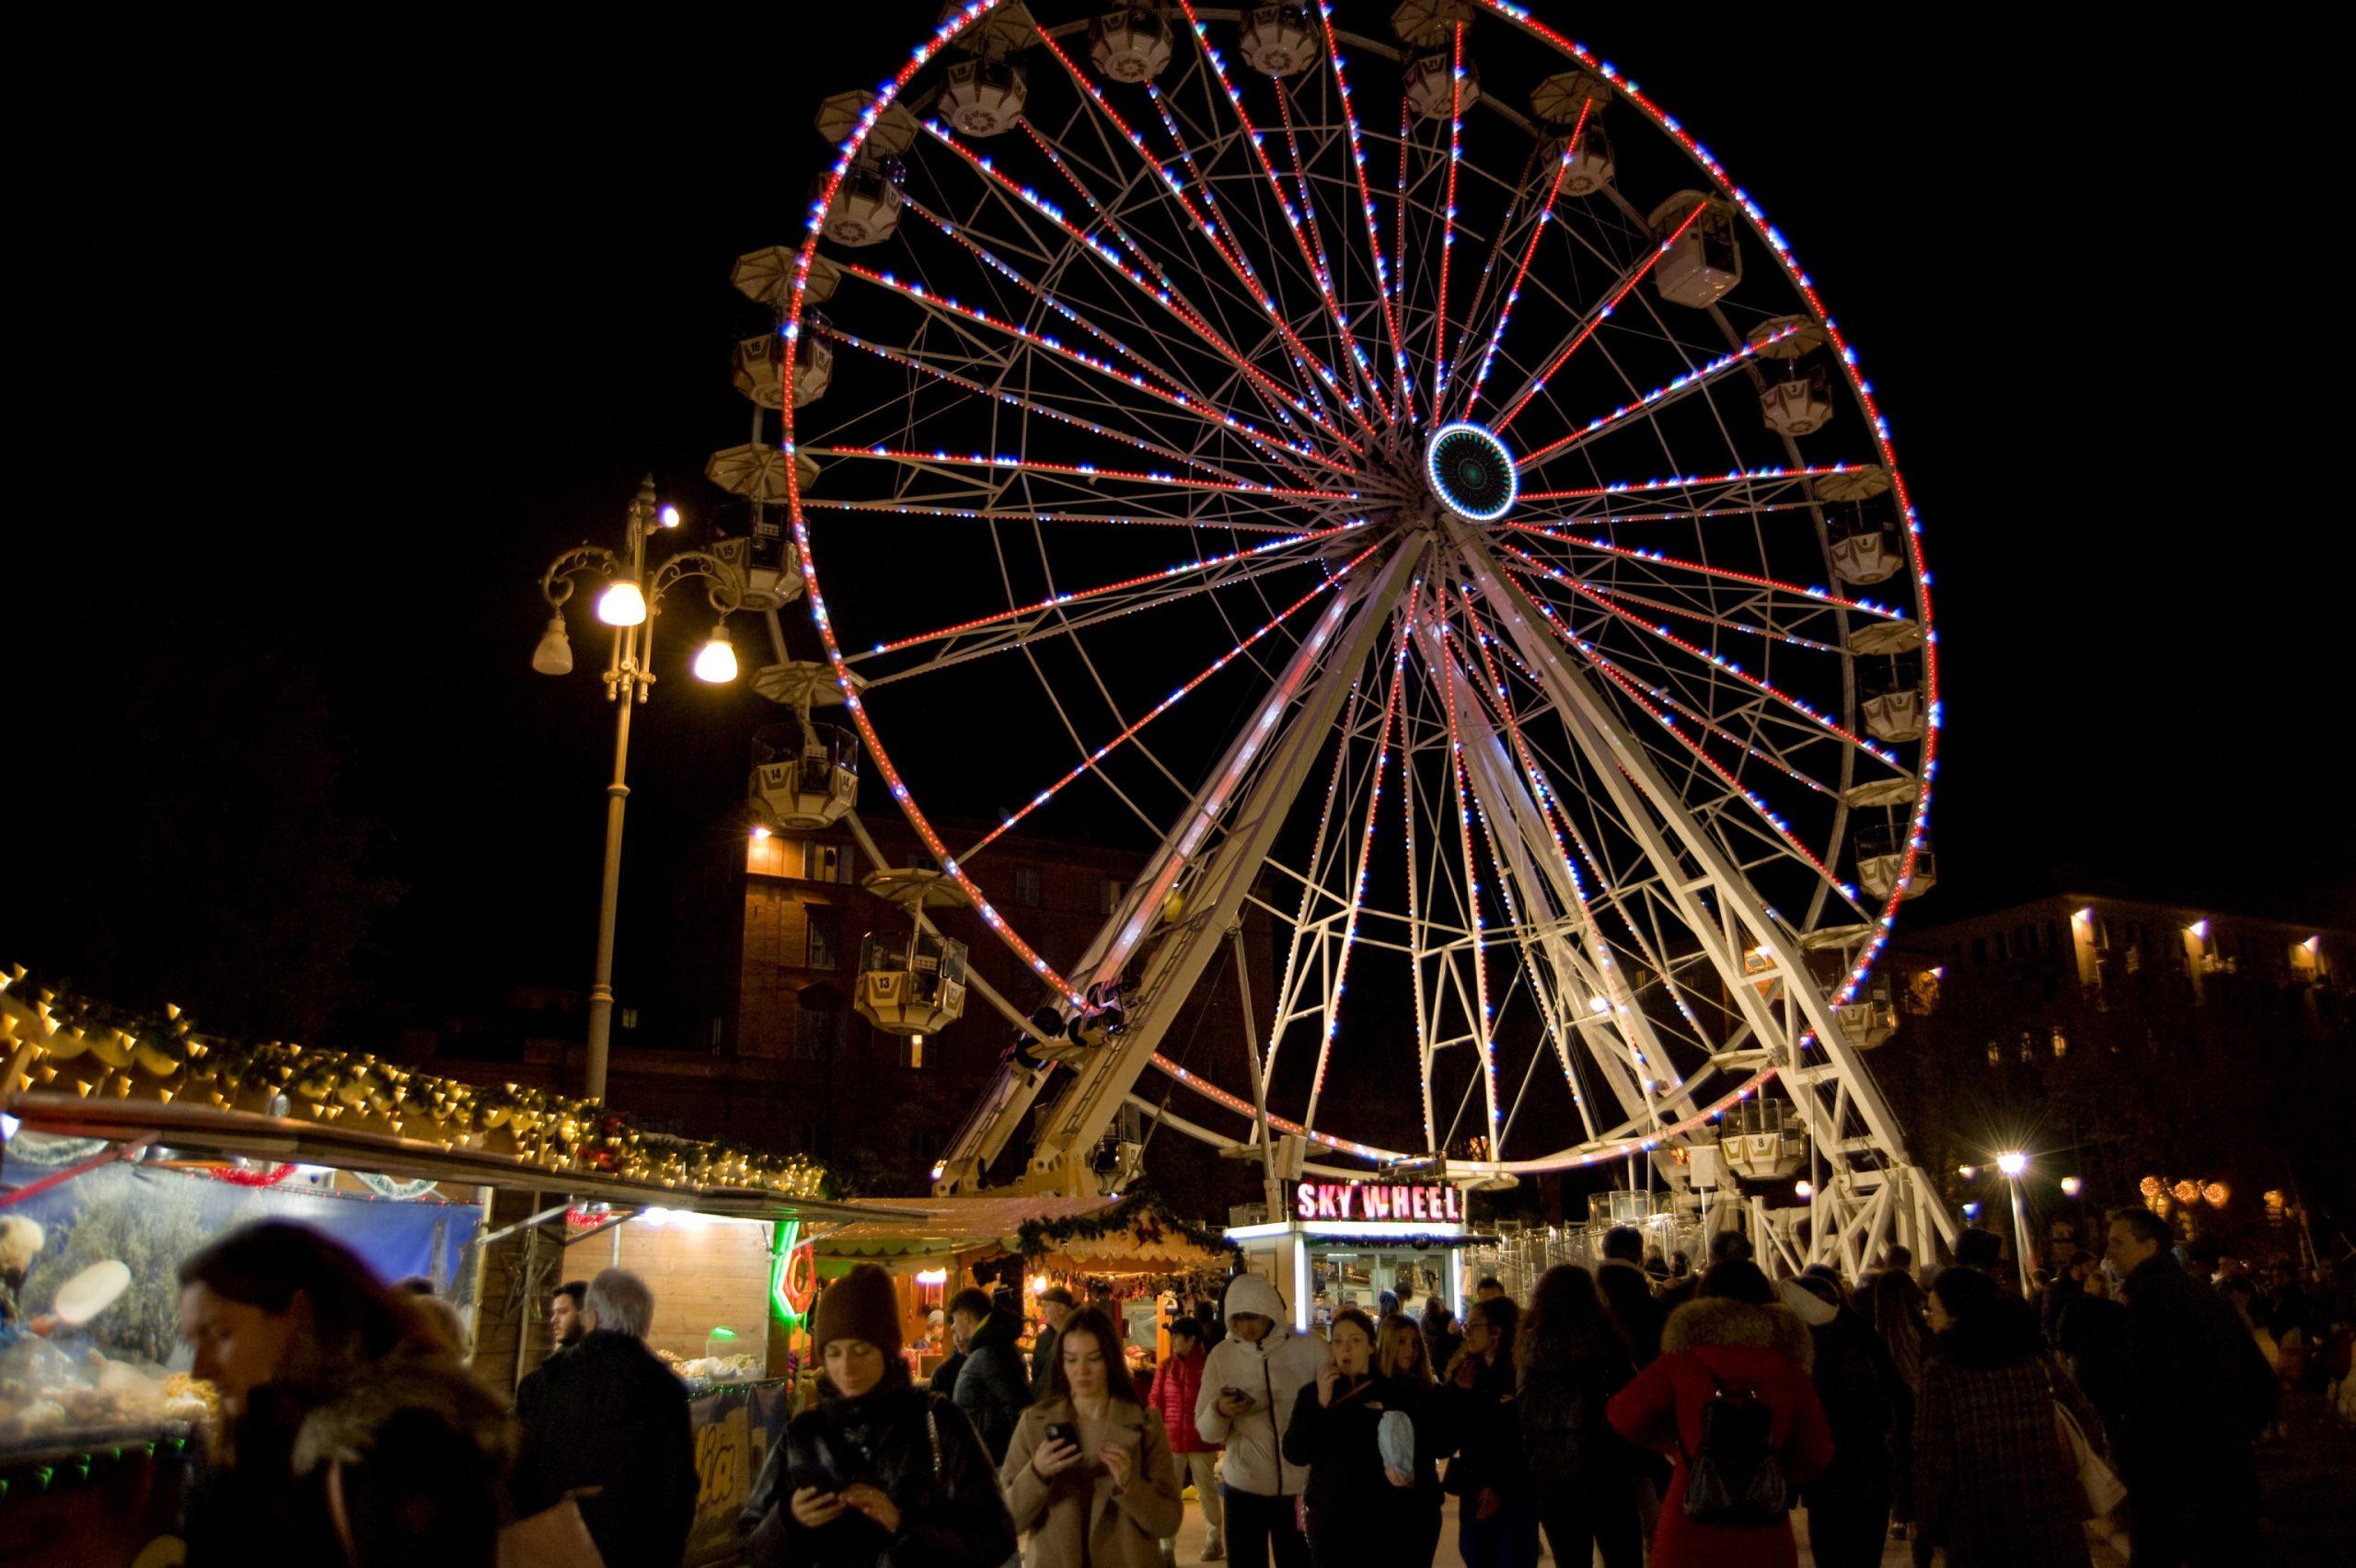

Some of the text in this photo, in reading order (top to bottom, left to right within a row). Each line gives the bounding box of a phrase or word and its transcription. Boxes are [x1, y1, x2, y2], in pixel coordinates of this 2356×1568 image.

[723, 545, 734, 557] 15
[771, 767, 781, 780] 14
[879, 976, 890, 989] 13
[1758, 1137, 1764, 1147] 8
[1298, 1182, 1460, 1220] SKY WHEEL
